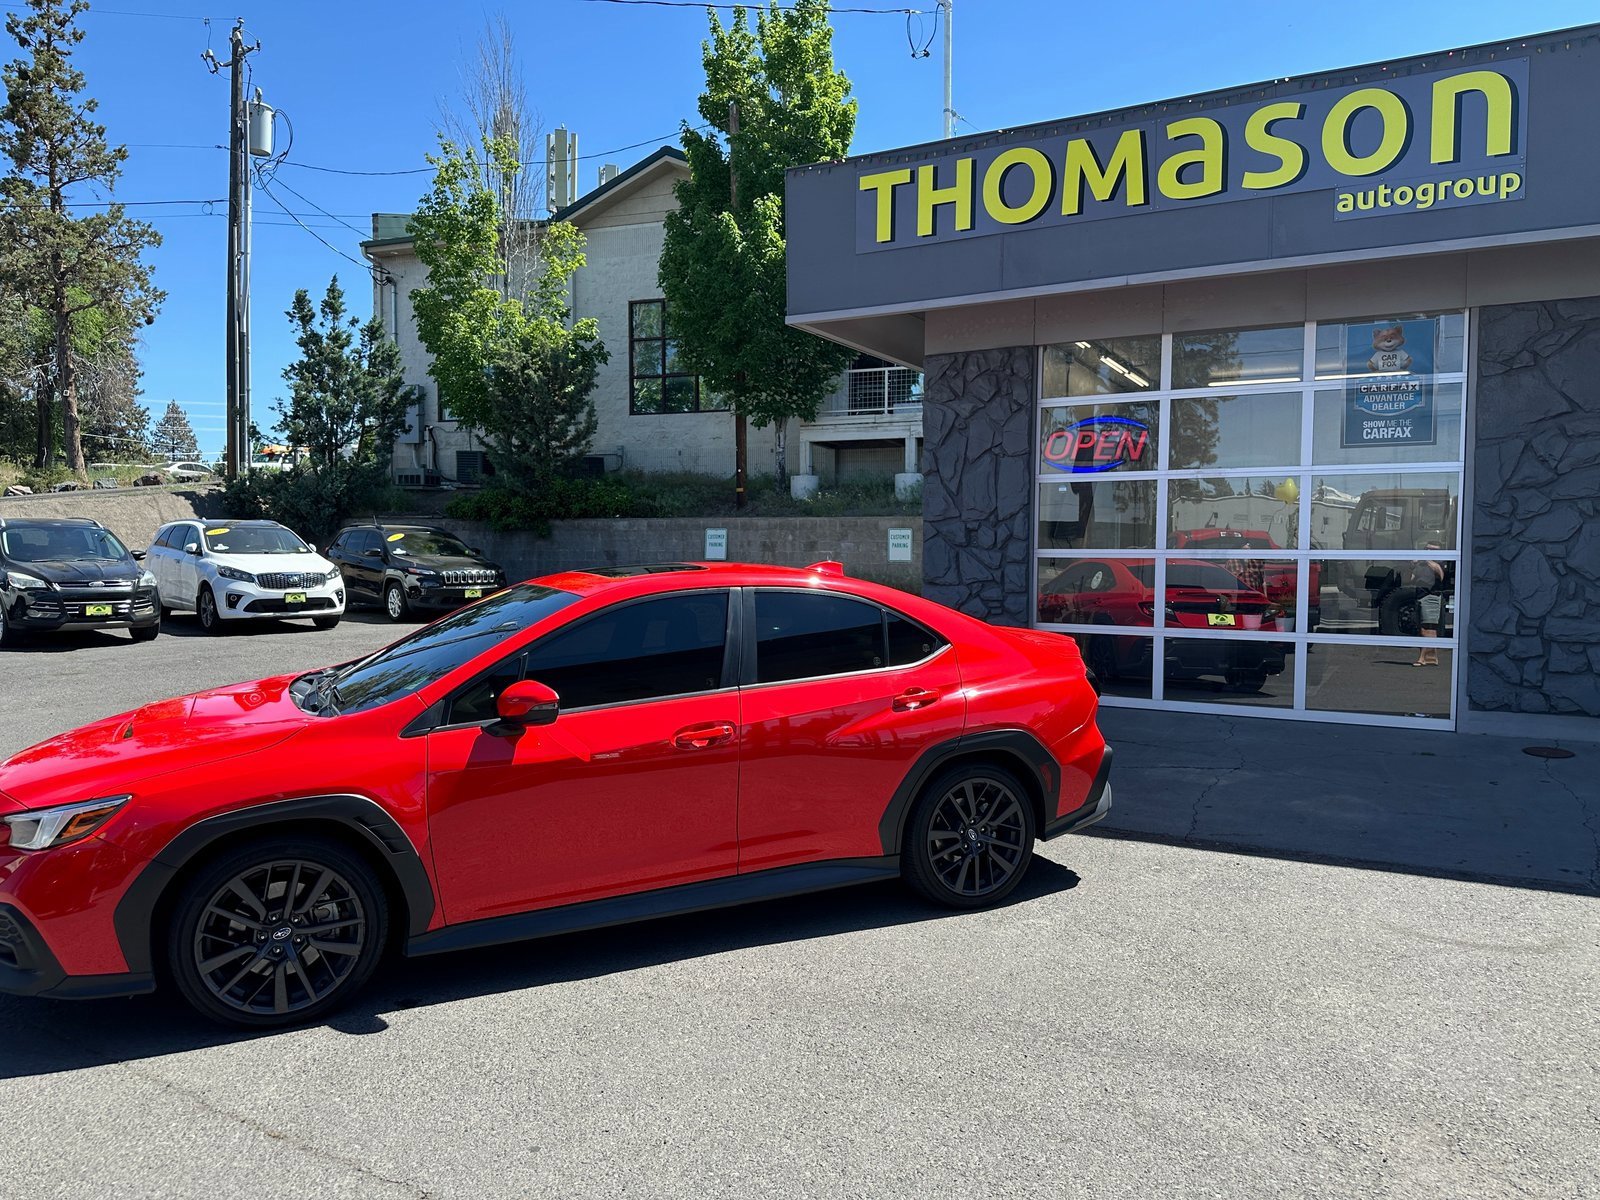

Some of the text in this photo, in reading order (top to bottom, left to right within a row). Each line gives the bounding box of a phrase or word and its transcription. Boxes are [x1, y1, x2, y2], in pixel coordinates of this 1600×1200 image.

[1336, 172, 1521, 213] autogroup
[1381, 353, 1398, 361] CAR
[1360, 382, 1419, 393] CARFAX
[1363, 392, 1415, 403] ADVANTAGE
[1372, 402, 1406, 411] DEALER
[1363, 419, 1412, 428] SHOW ME THE
[1363, 427, 1412, 439] CARFAX
[1044, 430, 1149, 461] OPEN
